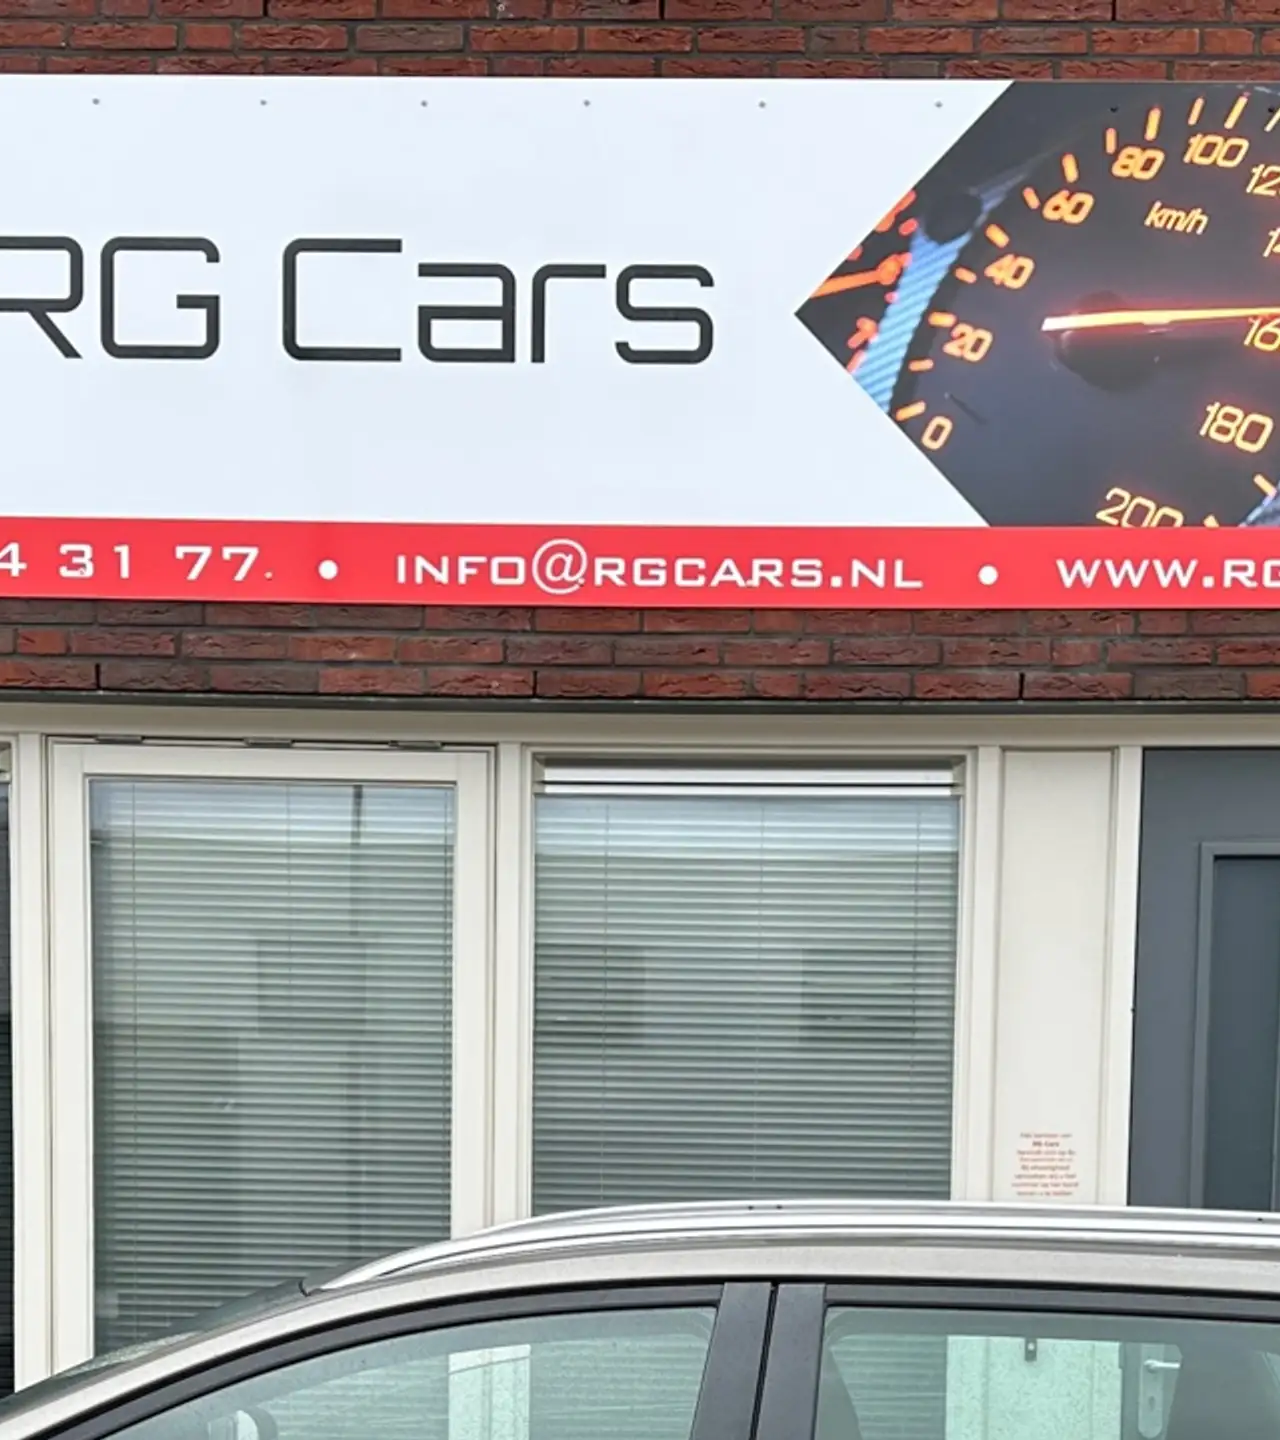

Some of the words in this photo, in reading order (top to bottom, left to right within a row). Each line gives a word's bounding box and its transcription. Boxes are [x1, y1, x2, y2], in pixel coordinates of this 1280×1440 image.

[1111, 146, 1165, 181] 80
[1183, 133, 1249, 168] 100
[1042, 189, 1095, 225] 60
[1144, 201, 1209, 236] km/h
[984, 253, 1035, 290] 40
[282, 237, 715, 365] Cars
[942, 322, 994, 362] 20
[921, 415, 953, 450] 0
[1199, 402, 1274, 453] 180
[59, 543, 130, 580] 31
[396, 538, 923, 595] INFO@RGCARS.NL
